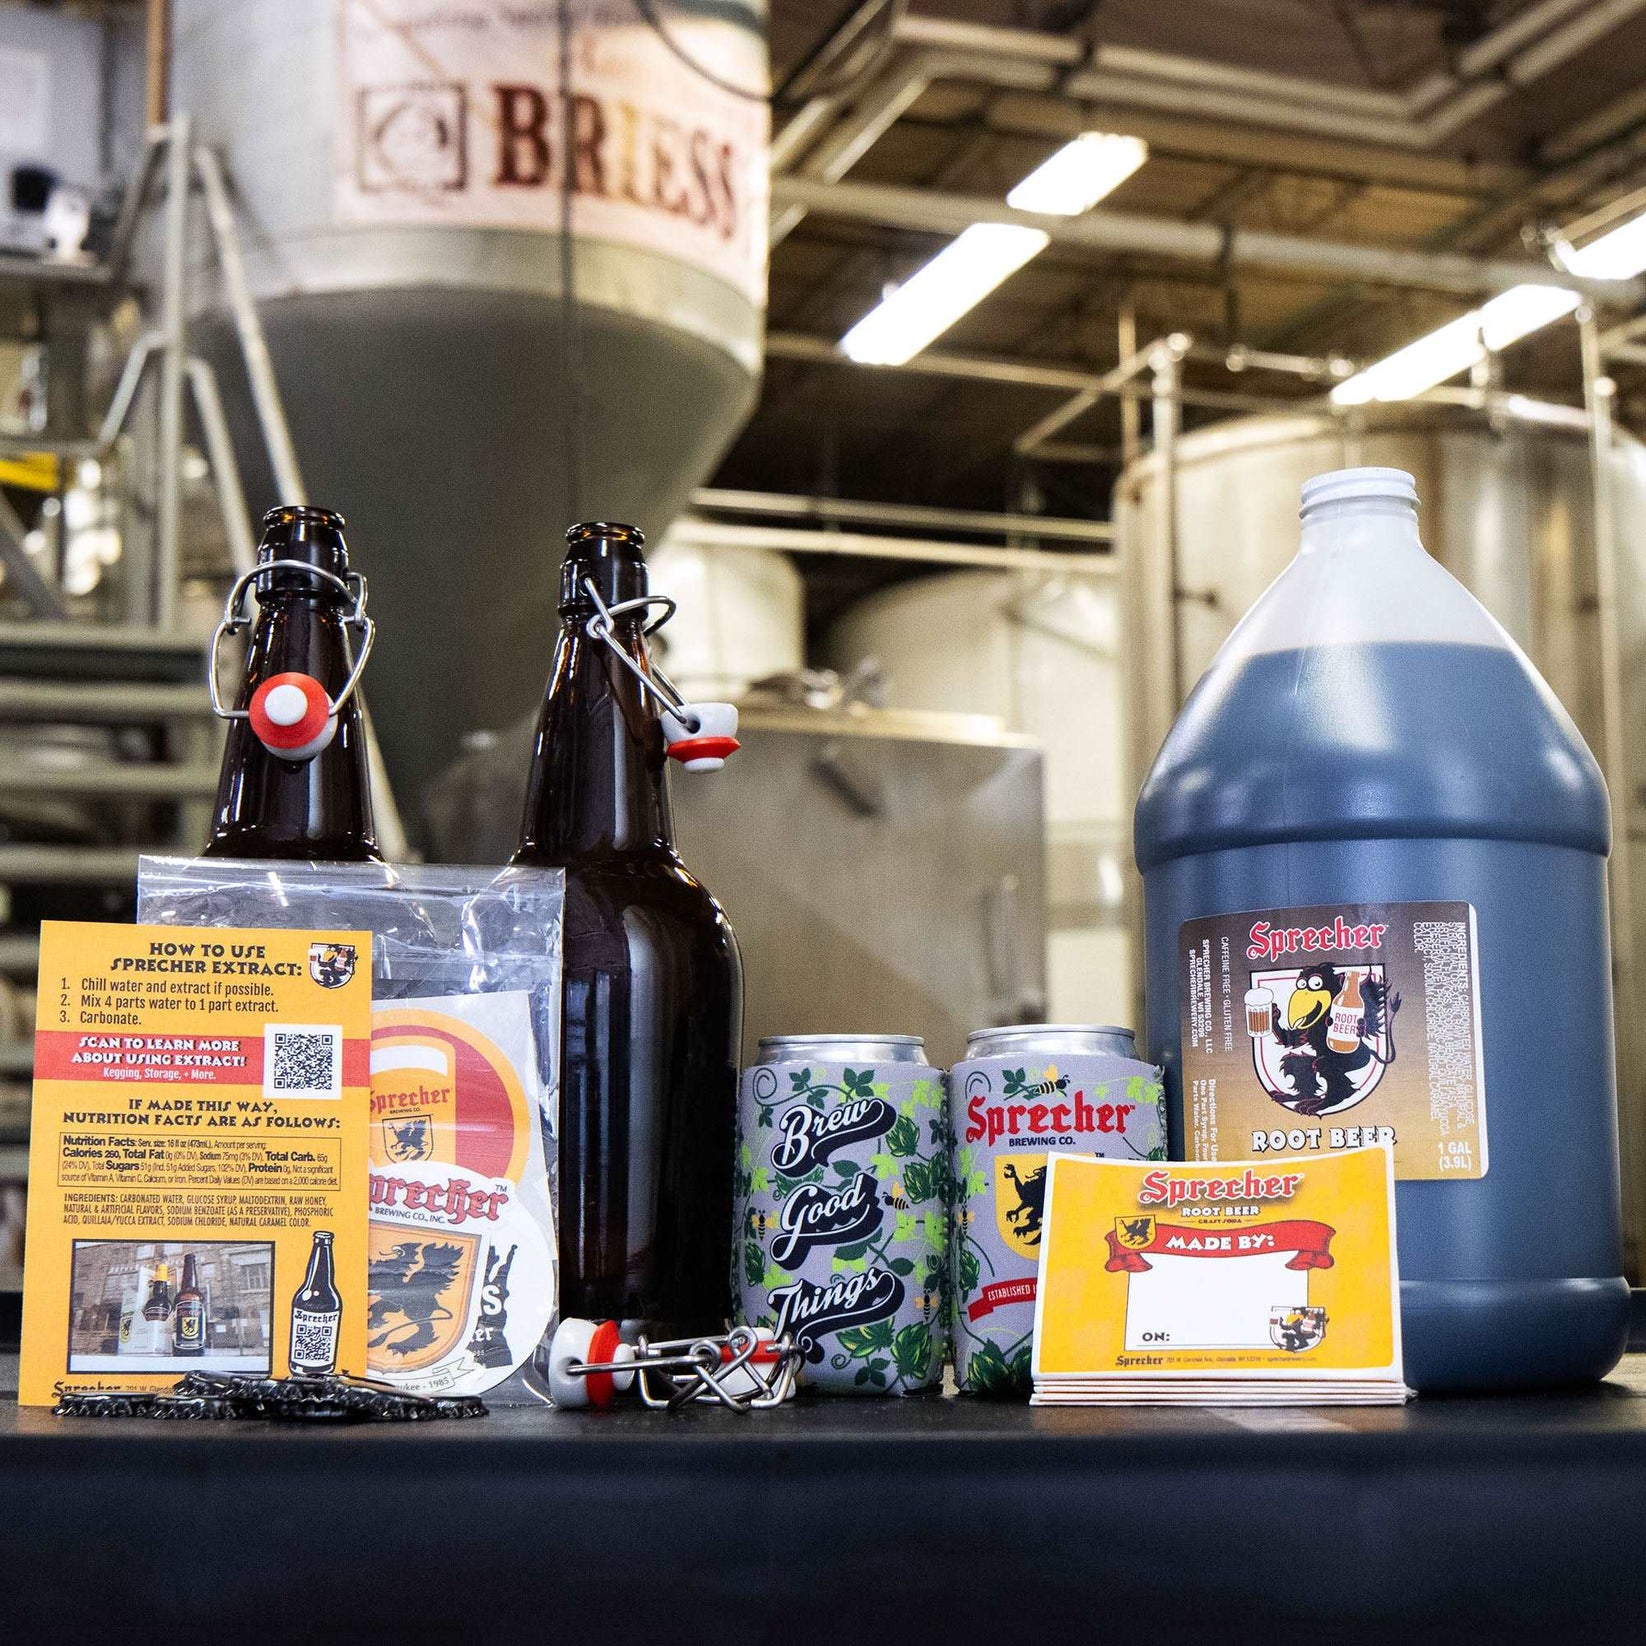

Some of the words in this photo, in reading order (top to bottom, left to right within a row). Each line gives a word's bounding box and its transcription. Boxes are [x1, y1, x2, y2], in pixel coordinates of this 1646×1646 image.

[1246, 916, 1386, 962] Sprecher
[1413, 922, 1423, 953] COLOR.
[150, 943, 196, 956] HOW
[200, 944, 224, 957] TO
[231, 946, 265, 958] USE
[1221, 937, 1229, 973] CAFFEINE
[1457, 922, 1468, 992] INGREDIENTS:
[111, 958, 206, 973] SPRECHER
[212, 961, 302, 976] EXTRACT:
[61, 978, 70, 989] 1.
[82, 978, 106, 991] Chill
[110, 980, 143, 992] water
[146, 981, 166, 993] and
[170, 982, 210, 994] extract
[214, 982, 222, 994] if
[225, 983, 274, 997] possible.
[1222, 974, 1230, 994] FREE
[61, 994, 70, 1006] 2.
[81, 994, 101, 1007] Mix
[105, 996, 112, 1007] 4
[116, 997, 145, 1010] parts
[149, 998, 182, 1009] water
[185, 998, 196, 1010] to
[200, 999, 205, 1010] 1
[209, 999, 232, 1013] part
[235, 1000, 278, 1012] extract.
[1189, 949, 1198, 1047] SPRECHERBREWERY.COM
[60, 1010, 70, 1023] 3.
[80, 1011, 141, 1025] Carbonate.
[1223, 1000, 1232, 1031] GLUTEN
[1335, 1013, 1357, 1024] ROOT
[1333, 1023, 1356, 1034] BEER
[79, 1037, 122, 1048] SCAN
[124, 1038, 145, 1049] TO
[147, 1039, 196, 1050] LEARN
[198, 1040, 240, 1051] MORE
[1224, 1032, 1232, 1052] FREE
[72, 1052, 124, 1064] ABOUT
[126, 1054, 172, 1065] USING
[174, 1055, 247, 1067] EXTRACT!
[103, 1067, 142, 1079] Kegging,
[145, 1068, 182, 1080] Storage,
[191, 1069, 216, 1080] More.
[129, 1099, 142, 1109] IF
[147, 1100, 192, 1111] MADE
[197, 1101, 231, 1111] THIS
[237, 1101, 277, 1114] WAY,
[63, 1112, 149, 1124] NUTRITION
[155, 1115, 202, 1126] FACTS
[207, 1116, 237, 1127] ARE
[242, 1117, 262, 1127] AS
[266, 1117, 340, 1128] FOLLOWS:
[966, 1091, 1130, 1147] Sprecher
[63, 1135, 105, 1146] Nutrition
[771, 1100, 891, 1173] Brew
[1009, 1137, 1055, 1147] BREWING
[1059, 1136, 1076, 1145] CO.
[1252, 1128, 1321, 1153] ROOT
[1329, 1125, 1397, 1148] BEER
[63, 1147, 102, 1157] Calories
[122, 1149, 146, 1158] Total
[149, 1150, 165, 1159] Fat
[200, 1152, 221, 1160] Sodium
[266, 1151, 288, 1161] Total
[291, 1152, 315, 1161] Carb.
[1438, 1142, 1444, 1153] 1
[1448, 1142, 1472, 1154] GAL
[106, 1160, 139, 1172] Sugars
[248, 1163, 282, 1173] Protein
[1439, 1155, 1472, 1171] (3.9L)
[1138, 1169, 1300, 1207] Sprecher
[64, 1193, 118, 1203] INGREDIENTS:
[120, 1194, 160, 1203] CARBONATED
[163, 1195, 184, 1204] WATER,
[187, 1195, 215, 1204] GLUCOSE
[240, 1196, 287, 1205] MALTODEXTRIN,
[289, 1196, 303, 1205] RAW
[305, 1197, 327, 1206] HONEY,
[369, 1173, 509, 1224] precher
[64, 1204, 91, 1213] NATURAL
[94, 1205, 99, 1213] &
[101, 1205, 133, 1214] ARTIFICIAL
[136, 1205, 164, 1215] FLAVORS,
[167, 1206, 191, 1215] SODIUM
[194, 1206, 225, 1215] BENZOATE
[227, 1207, 237, 1216] (AS
[240, 1207, 243, 1215] A
[294, 1207, 333, 1216] PHOSPHORIC
[375, 1207, 410, 1219] BREWING
[1182, 1207, 1220, 1216] ROOT
[1224, 1206, 1259, 1216] BEER
[63, 1215, 80, 1225] ACID,
[138, 1216, 165, 1226] EXTRACT,
[168, 1217, 192, 1226] SODIUM
[195, 1217, 227, 1227] CHLORIDE,
[230, 1218, 256, 1226] NATURAL
[260, 1218, 286, 1226] CARAMEL
[289, 1218, 311, 1227] COLOR.
[771, 1174, 877, 1264] Good
[1165, 1235, 1232, 1250] MADE
[1238, 1233, 1275, 1249] BY:
[988, 1285, 1030, 1301] ESTABLISHED
[295, 1310, 337, 1323] Sprecher
[768, 1268, 900, 1352] Things
[1142, 1332, 1170, 1341] ON:
[1115, 1355, 1163, 1367] Sprecher
[429, 1377, 449, 1388] 1985
